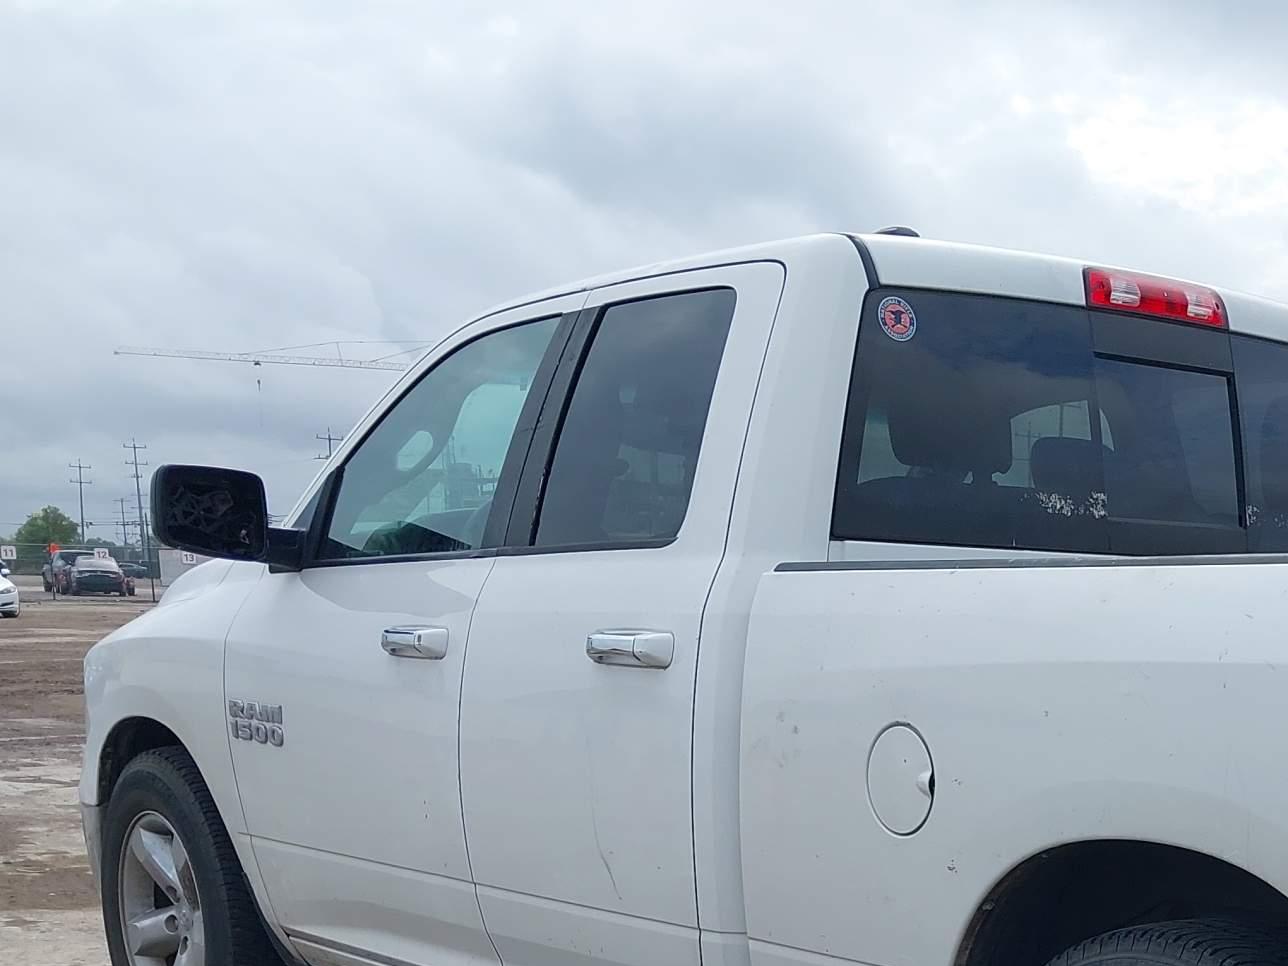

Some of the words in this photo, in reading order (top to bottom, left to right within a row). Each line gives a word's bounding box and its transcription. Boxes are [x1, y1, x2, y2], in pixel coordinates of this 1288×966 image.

[3, 549, 13, 557] 11
[96, 551, 107, 559] 12
[184, 553, 194, 562] 13
[229, 700, 282, 724] RAM
[230, 720, 284, 747] 1500
